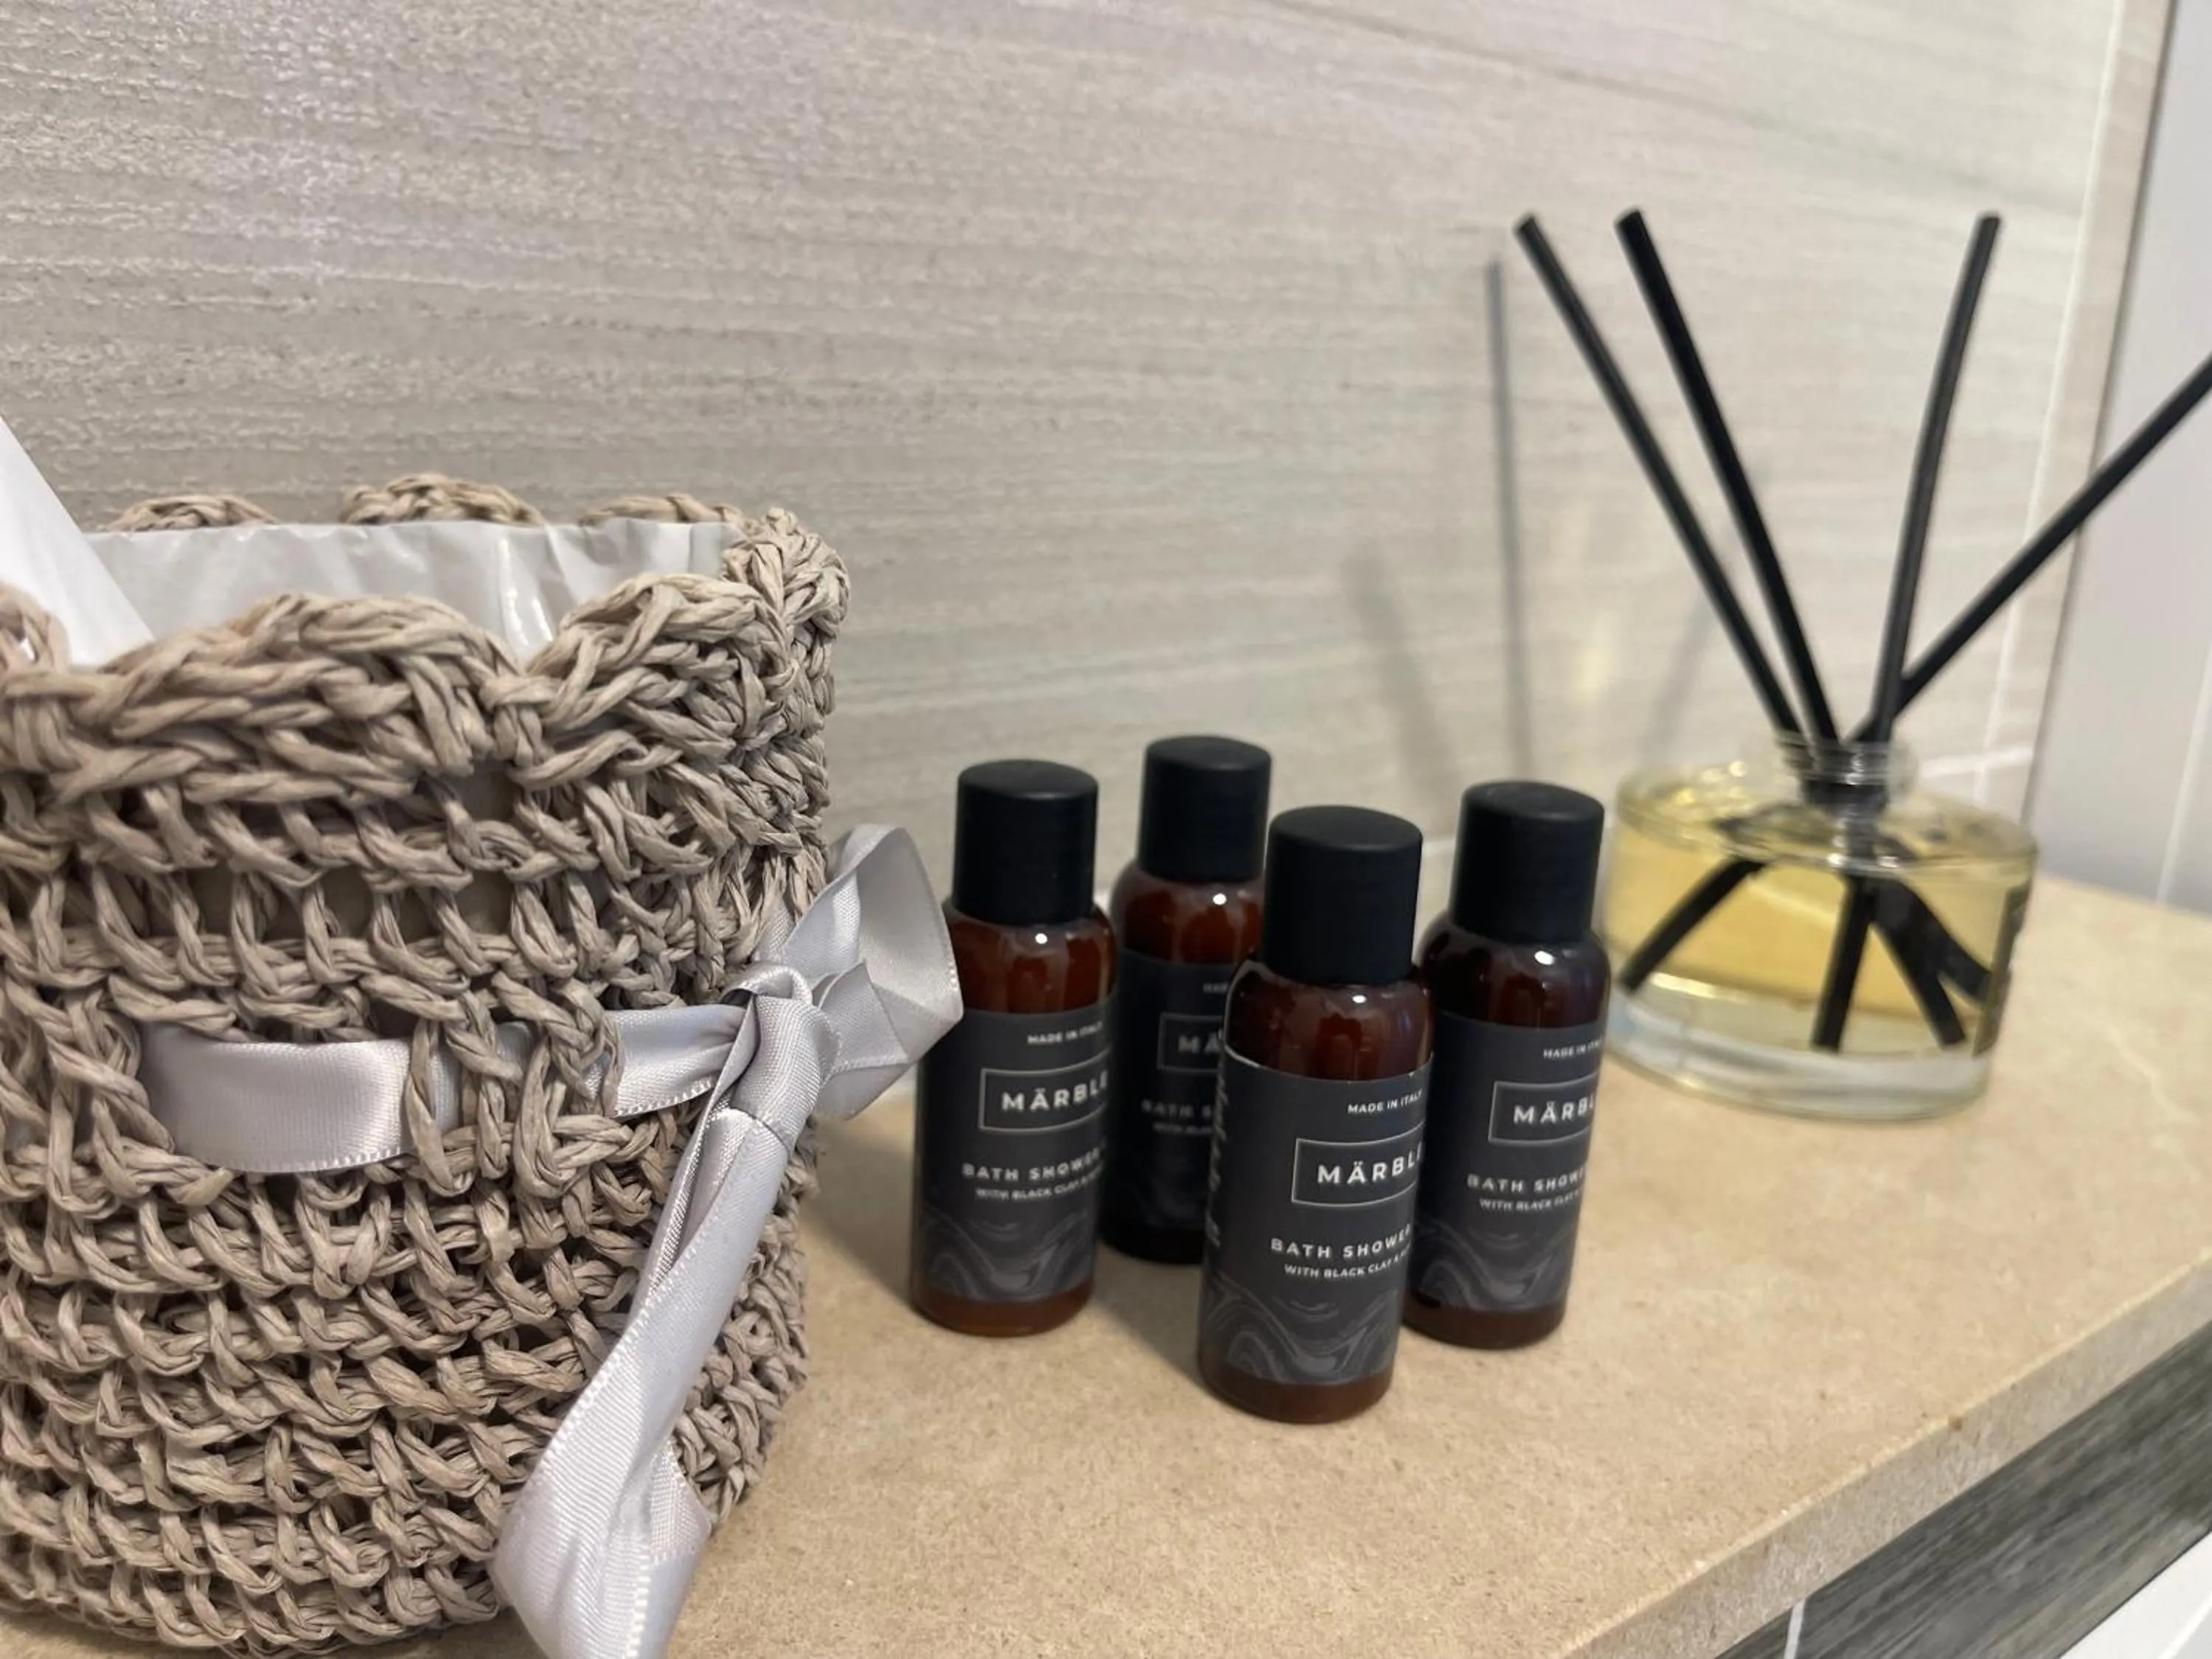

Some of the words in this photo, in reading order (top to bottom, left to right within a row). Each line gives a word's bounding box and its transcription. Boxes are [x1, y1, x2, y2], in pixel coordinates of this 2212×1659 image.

[1347, 1102, 1384, 1114] MADE
[1386, 1099, 1398, 1110] IN
[961, 1163, 1020, 1181] BATH
[1467, 1173, 1524, 1193] BATH
[975, 1186, 1009, 1201] WITH
[1011, 1187, 1053, 1202] BLACK
[1479, 1198, 1512, 1211] WITH
[1516, 1199, 1552, 1212] BLACK
[1270, 1238, 1330, 1259] BATH
[1284, 1264, 1319, 1279] WITH
[1324, 1266, 1366, 1279] BLACK
